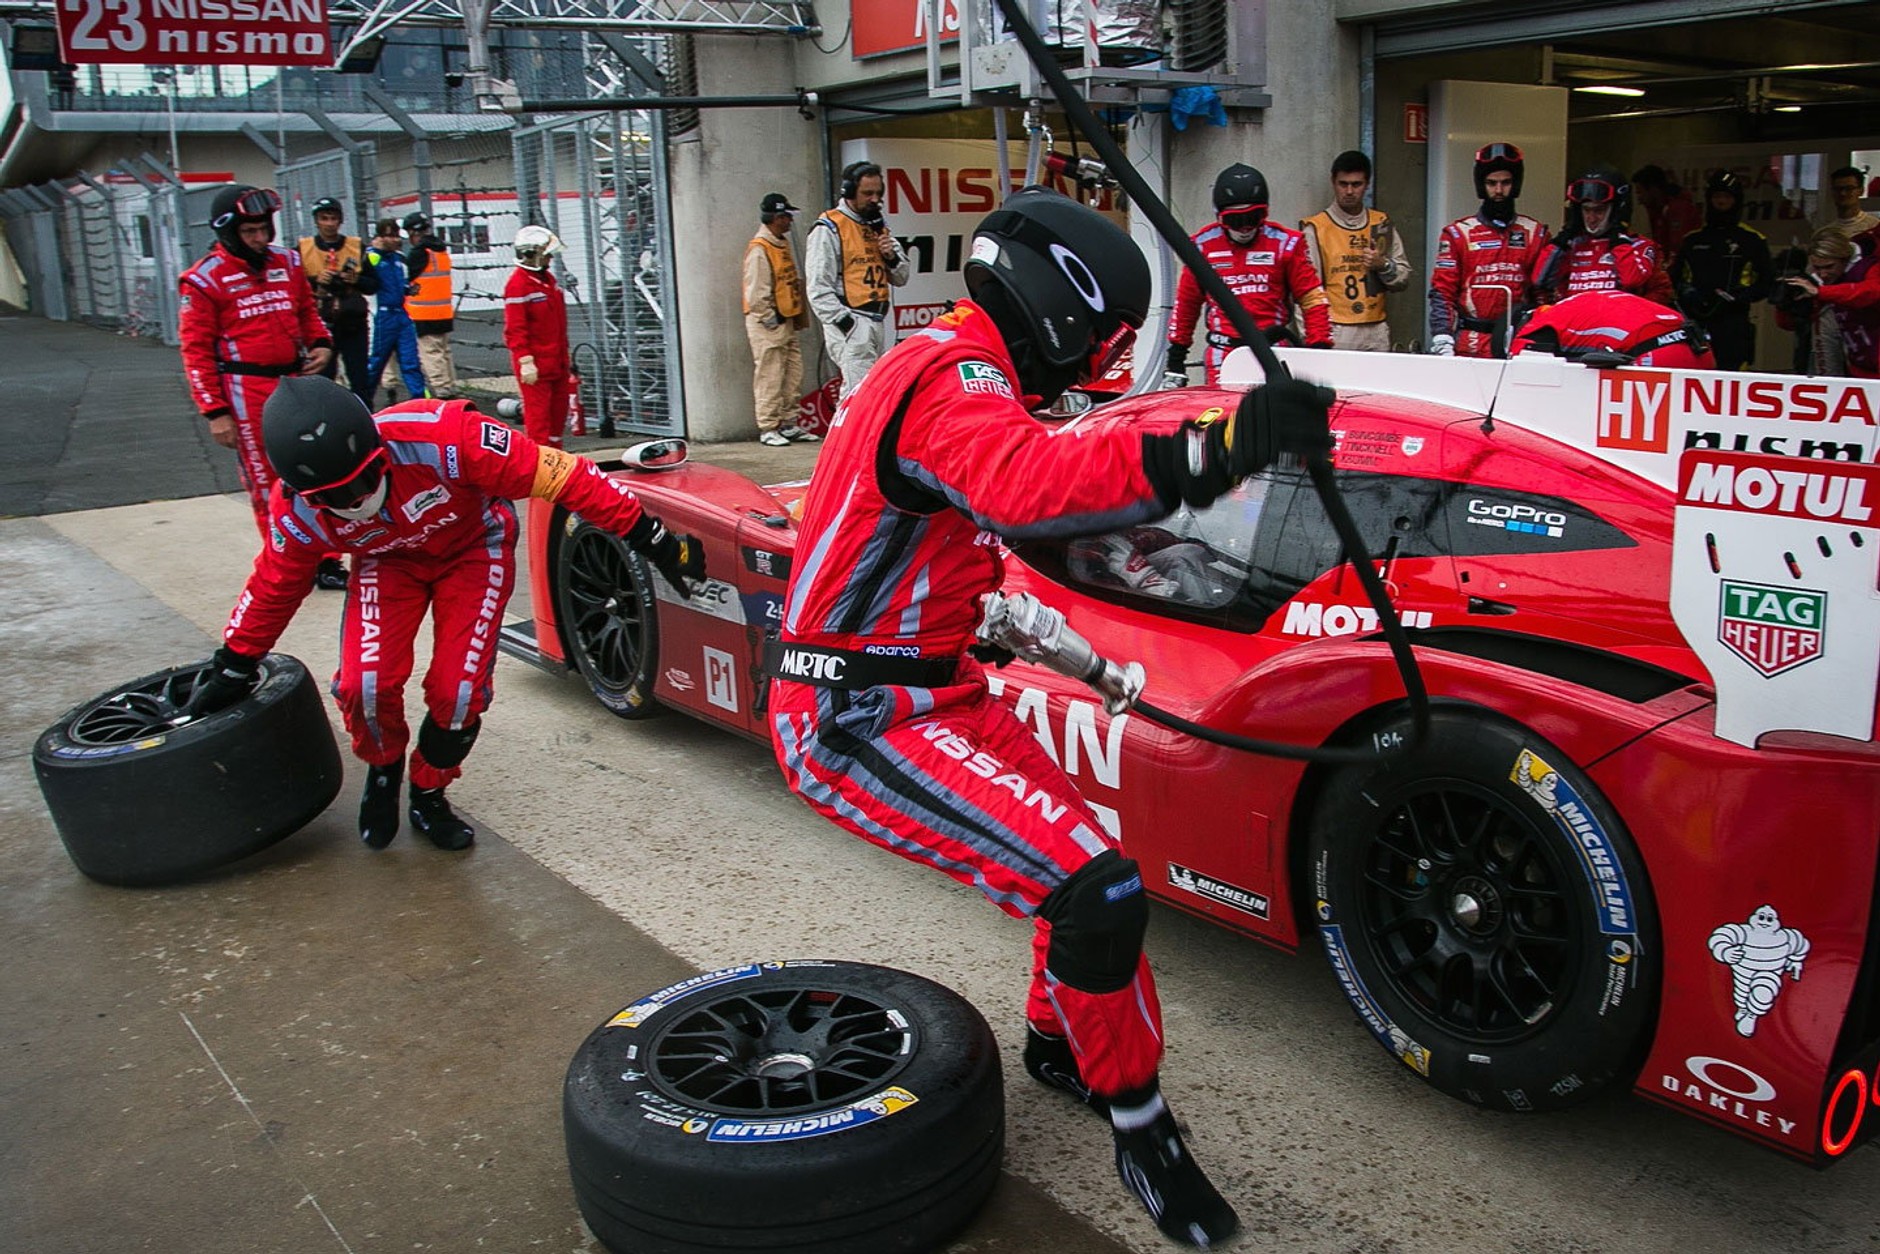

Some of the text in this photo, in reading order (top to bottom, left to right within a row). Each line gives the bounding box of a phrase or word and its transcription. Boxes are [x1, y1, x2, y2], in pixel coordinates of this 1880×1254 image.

[64, 0, 147, 51] 23
[152, 0, 323, 23] NISSAN
[158, 30, 325, 54] nismo
[863, 265, 887, 289] 42
[1600, 379, 1668, 441] HY
[1468, 499, 1567, 526] GoPro
[1685, 461, 1873, 521] MOTUL
[359, 558, 381, 663] NISSAN
[464, 564, 504, 673] nismo
[1730, 587, 1816, 625] TAG
[780, 649, 847, 681] MRTC
[1725, 621, 1816, 669] HEUER
[709, 655, 732, 703] P1
[910, 721, 1068, 825] NISSAN
[1559, 801, 1629, 929] MICHELIN
[1197, 877, 1267, 911] MICHELIN
[650, 964, 754, 1002] MICHELIN
[1322, 930, 1387, 1035] MICHELIN
[715, 1110, 854, 1137] MICHELIN
[1662, 1074, 1796, 1134] OAKLEY
